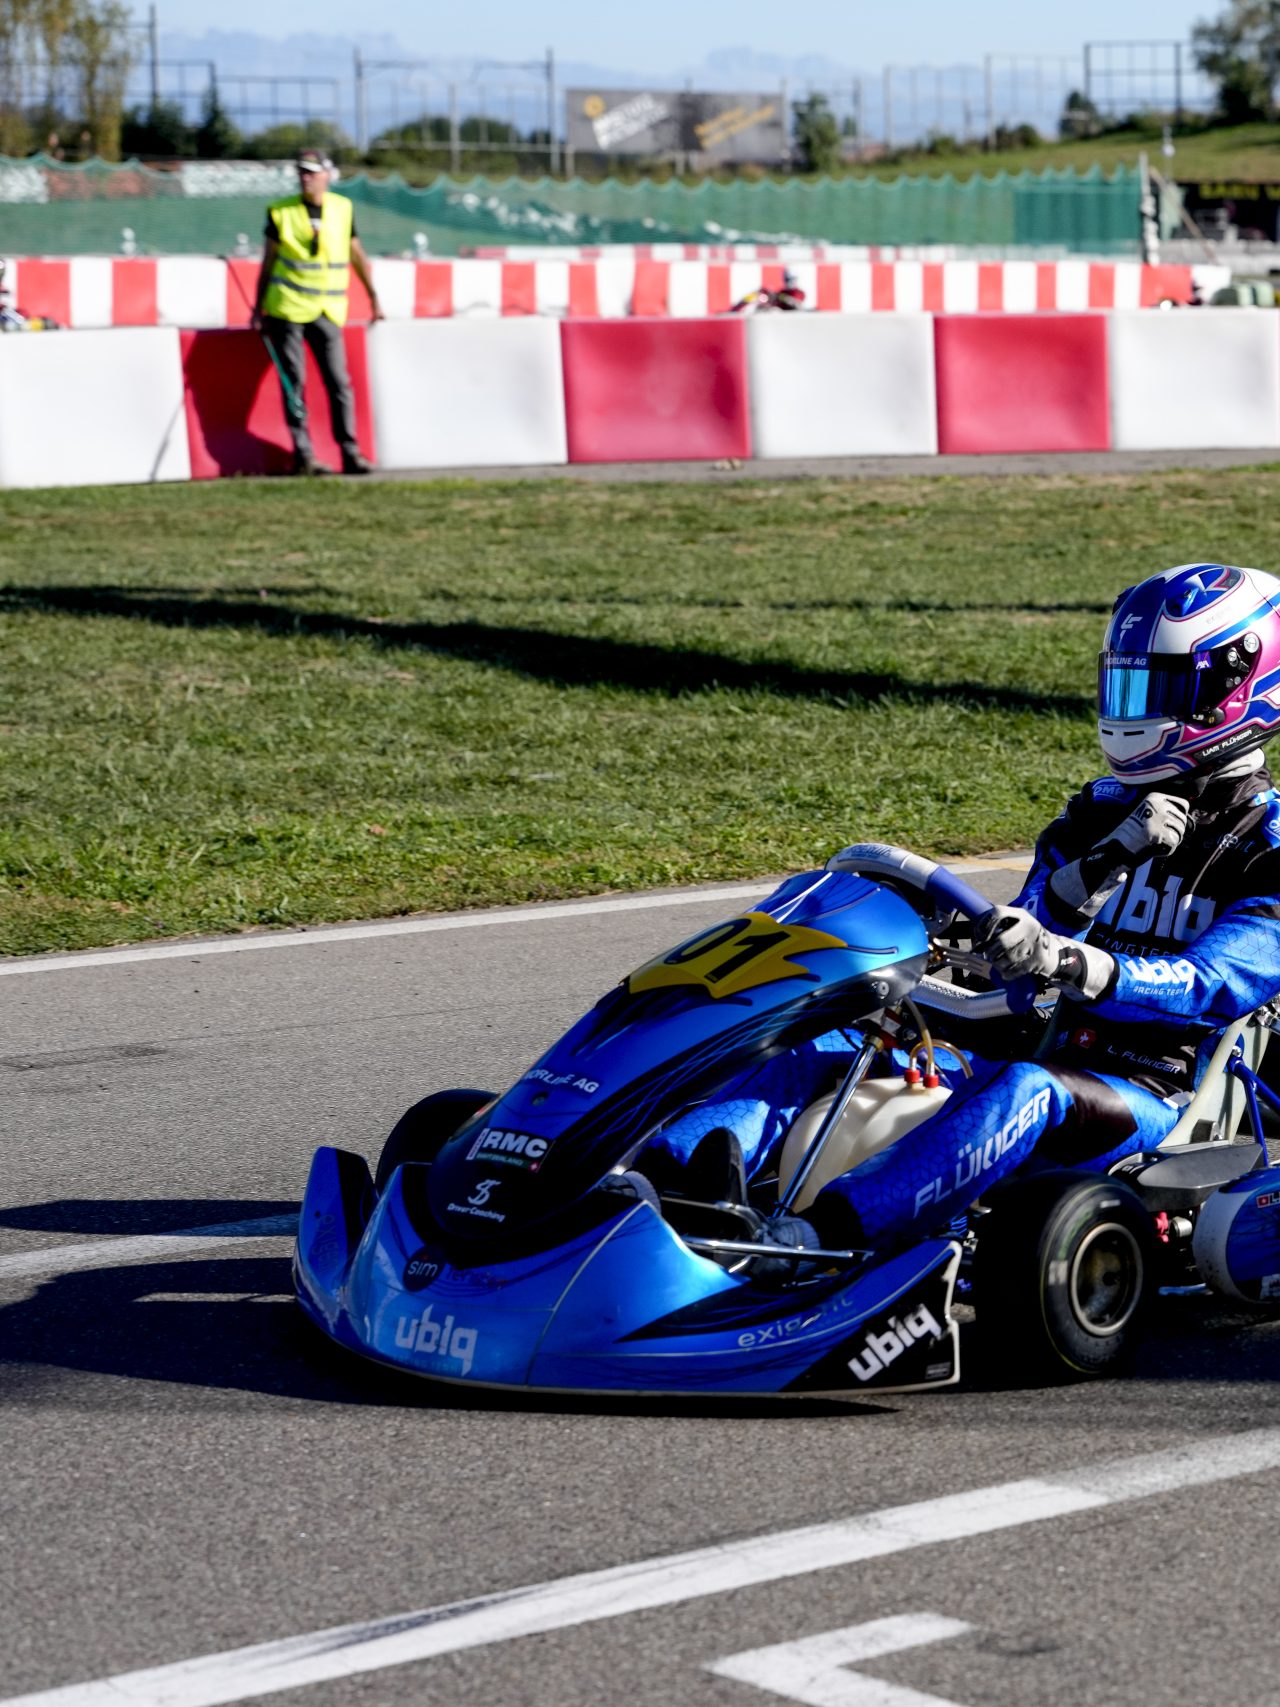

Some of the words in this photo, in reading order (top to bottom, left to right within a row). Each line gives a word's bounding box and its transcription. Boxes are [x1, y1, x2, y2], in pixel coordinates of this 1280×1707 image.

[1134, 656, 1147, 666] AG
[1202, 745, 1220, 757] LIAM
[1133, 985, 1164, 996] RACING
[572, 1077, 600, 1094] AG
[482, 1131, 548, 1158] RMC
[913, 1087, 1051, 1219] FLÜKIGER
